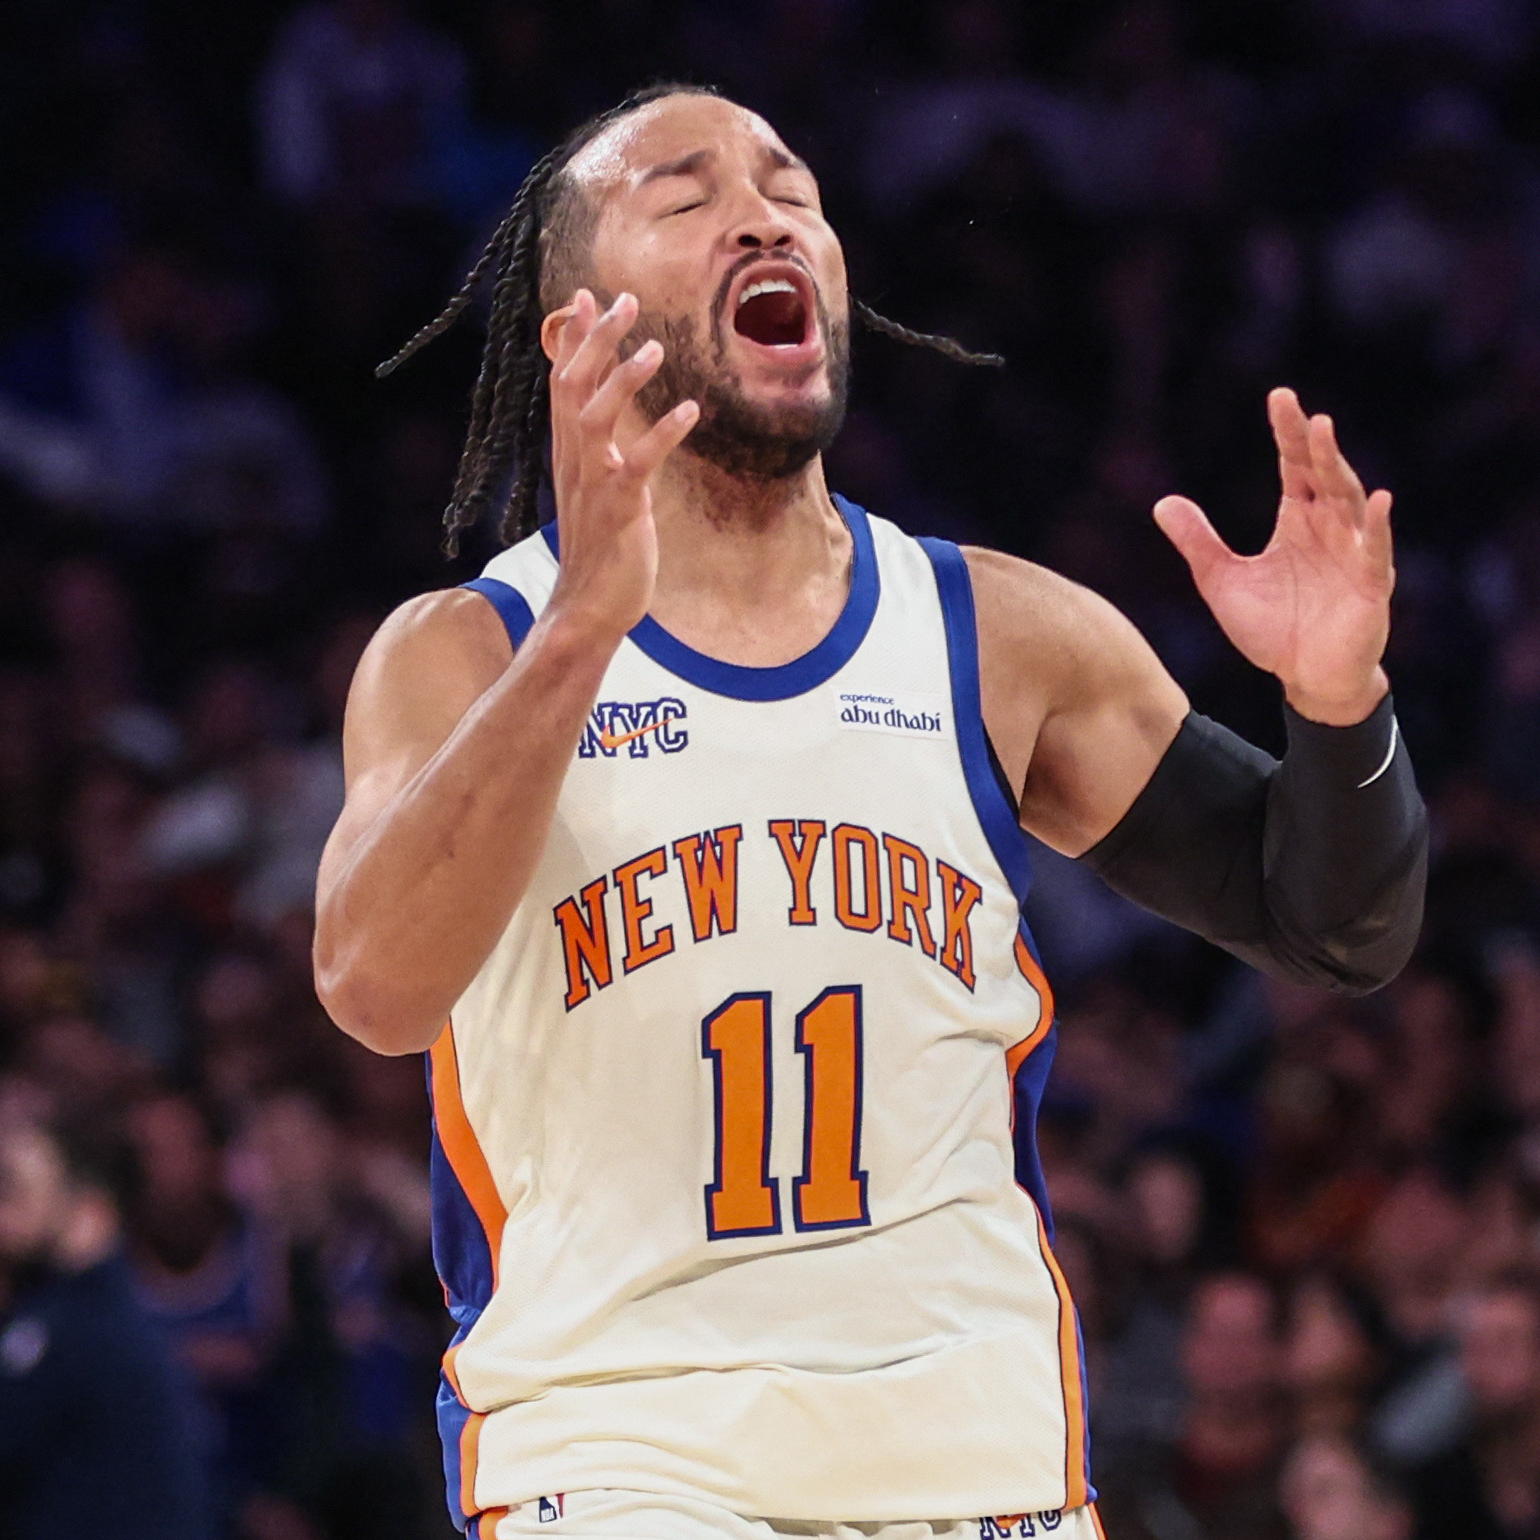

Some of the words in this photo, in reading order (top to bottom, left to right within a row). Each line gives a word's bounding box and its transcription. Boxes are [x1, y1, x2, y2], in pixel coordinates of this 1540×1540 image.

[579, 697, 688, 758] NYC
[839, 693, 894, 705] experience
[840, 704, 880, 725] abu
[884, 708, 941, 732] dhabi
[553, 824, 743, 1013] NEW
[768, 819, 983, 994] YORK
[701, 984, 872, 1242] 11
